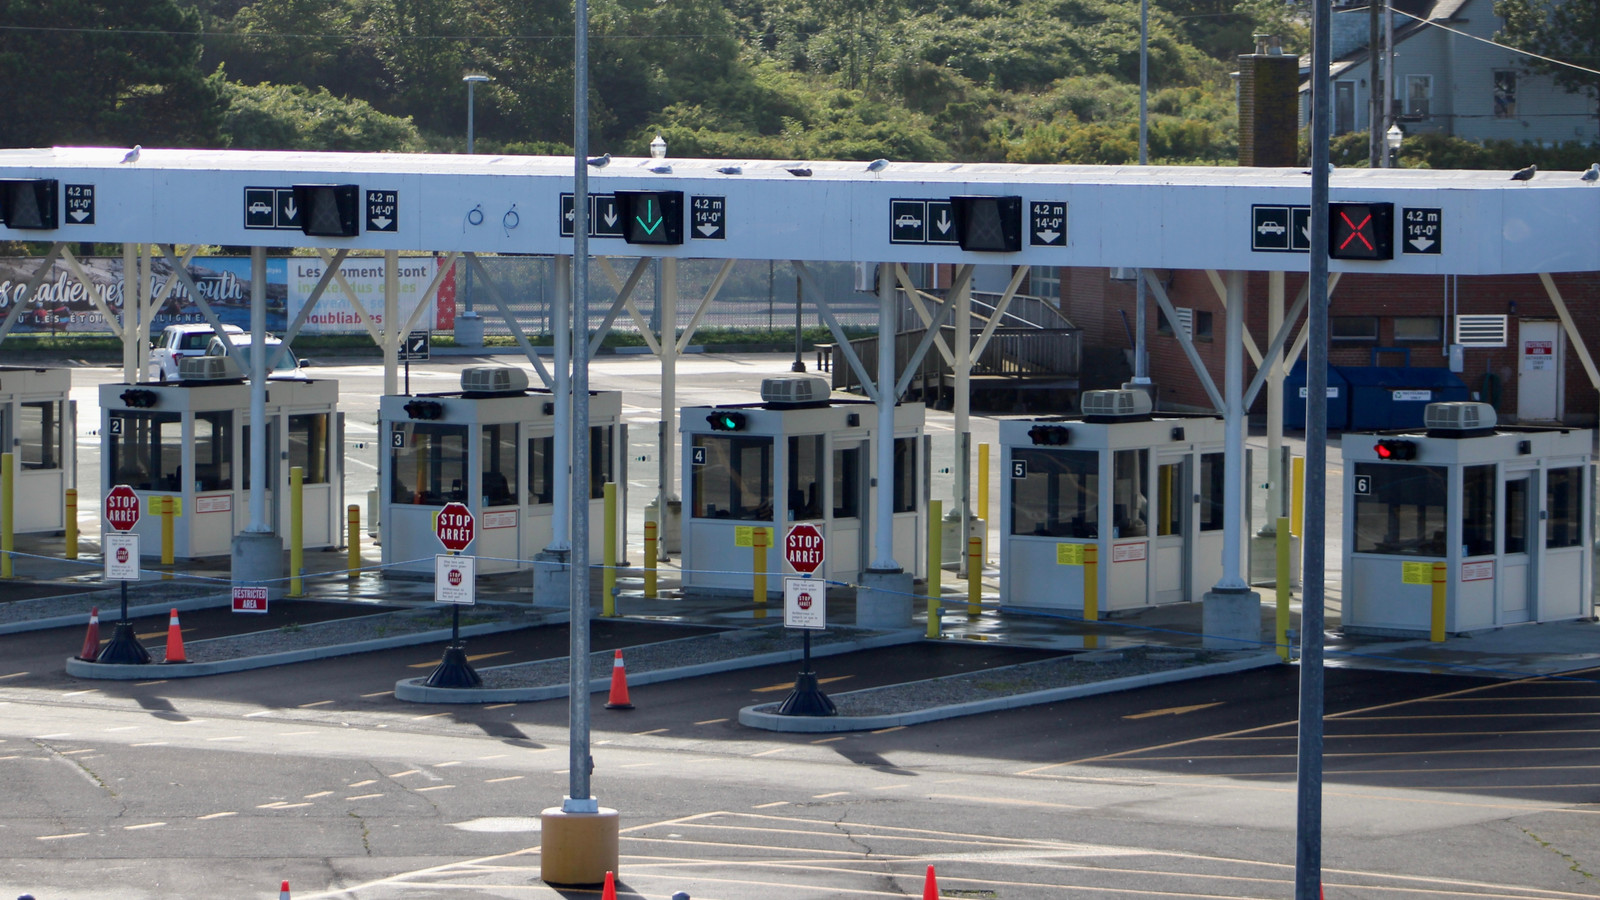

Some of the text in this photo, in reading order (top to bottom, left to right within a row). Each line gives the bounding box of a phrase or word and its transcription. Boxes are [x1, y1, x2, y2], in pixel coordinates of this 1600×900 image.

[68, 187, 80, 196] 4.2
[370, 193, 382, 202] 4.2
[695, 200, 708, 208] 4.2
[1034, 204, 1050, 214] 4.2
[1407, 211, 1438, 221] 4.2 m
[298, 266, 320, 278] Les
[398, 266, 426, 278] sont
[112, 420, 119, 431] 2
[395, 434, 401, 446] 3
[696, 450, 702, 462] 4
[1016, 464, 1022, 476] 5
[1358, 479, 1366, 491] 6
[110, 496, 136, 508] STOP
[110, 508, 136, 522] ARRÊT
[441, 514, 470, 526] STOP
[441, 527, 470, 541] ARRÊT
[790, 535, 820, 548] STOP
[790, 548, 820, 562] ARRÊT
[234, 590, 266, 598] RESTRICTED
[242, 600, 257, 608] AREA
